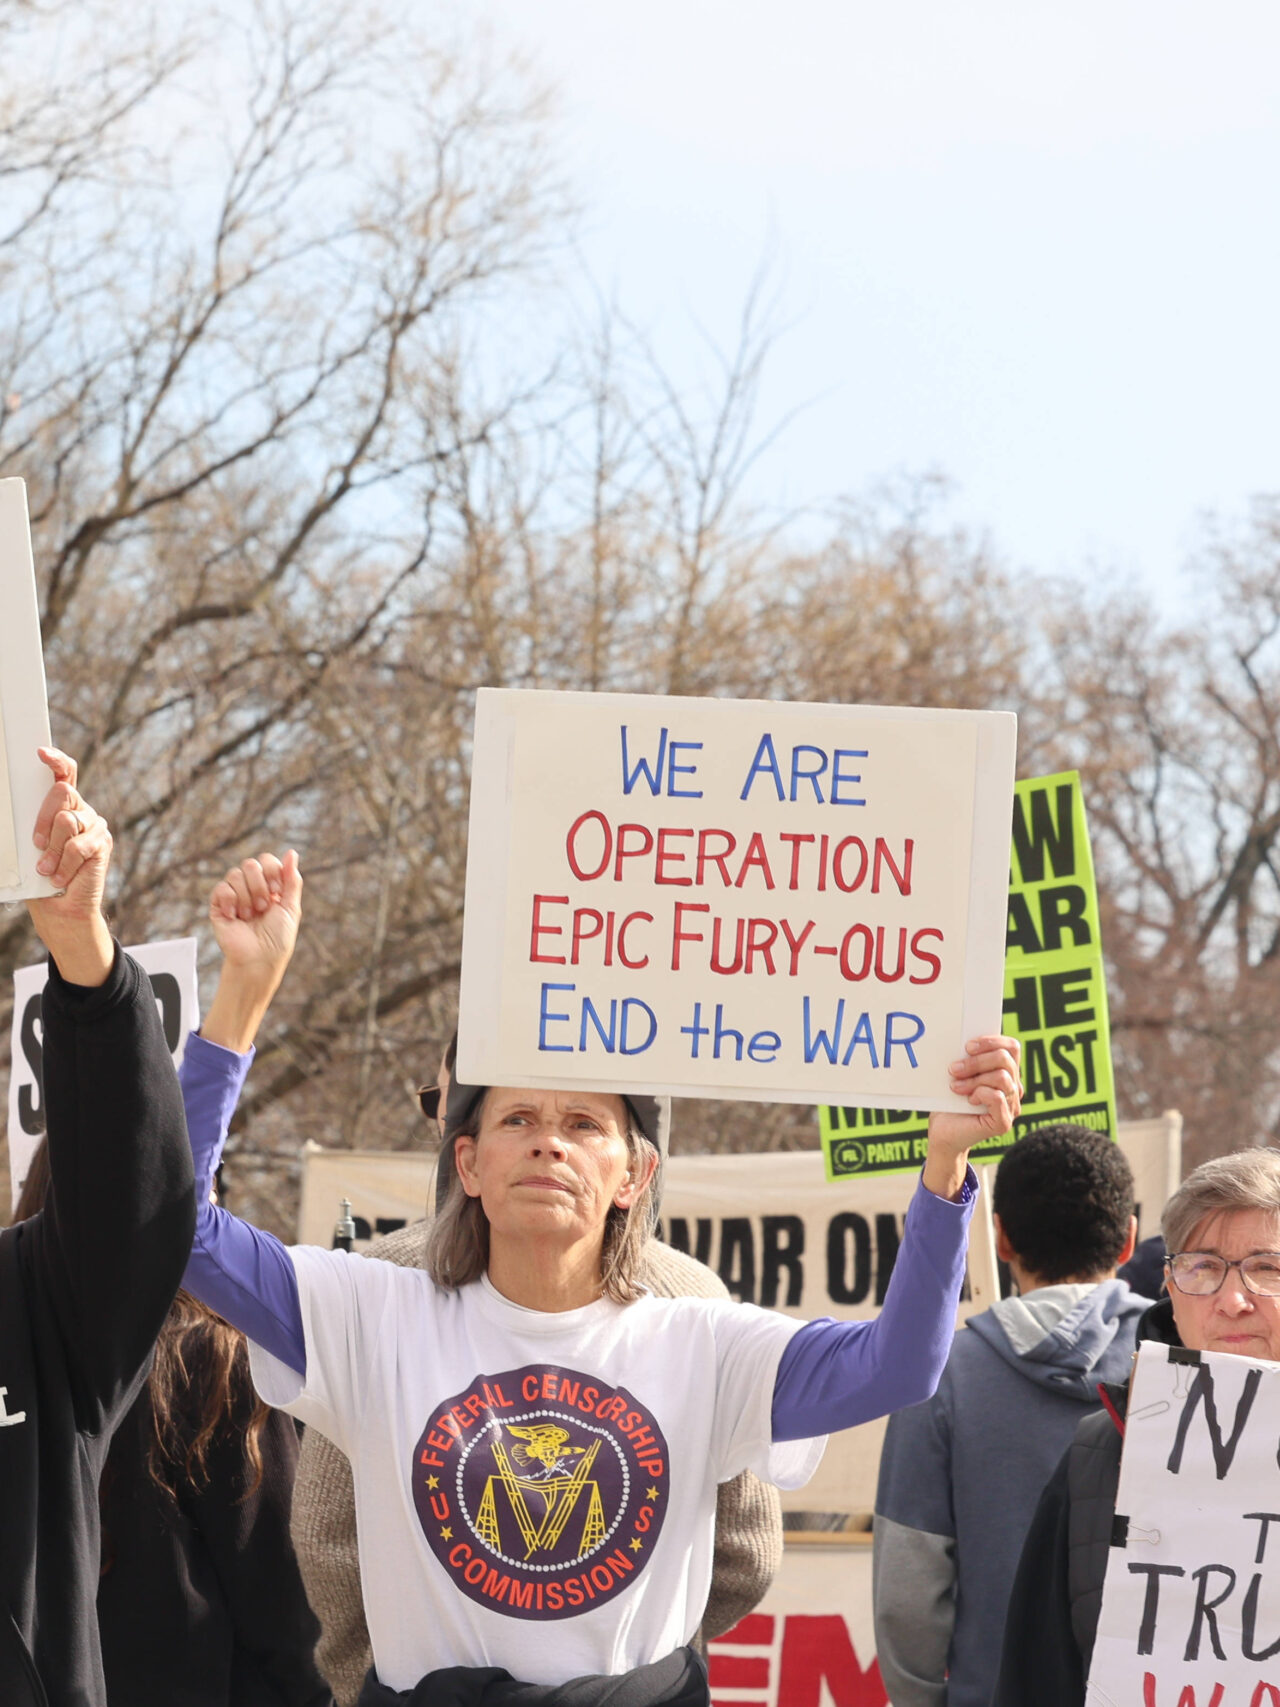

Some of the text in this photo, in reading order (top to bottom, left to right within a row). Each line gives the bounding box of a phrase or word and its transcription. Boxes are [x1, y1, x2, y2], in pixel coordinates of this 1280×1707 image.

[621, 726, 869, 806] WE ARE
[566, 810, 914, 896] OPERATION
[530, 894, 944, 984] EPIC FURY-OUS
[538, 983, 925, 1069] END the WAR
[1002, 968, 1096, 1032] HE
[1021, 1030, 1098, 1104] AST
[867, 1139, 911, 1163] PARTY
[421, 1374, 664, 1478] FEDERAL CENSORSHIP
[430, 1492, 450, 1520] U
[634, 1506, 654, 1532] S
[448, 1543, 634, 1610] COMMISSION
